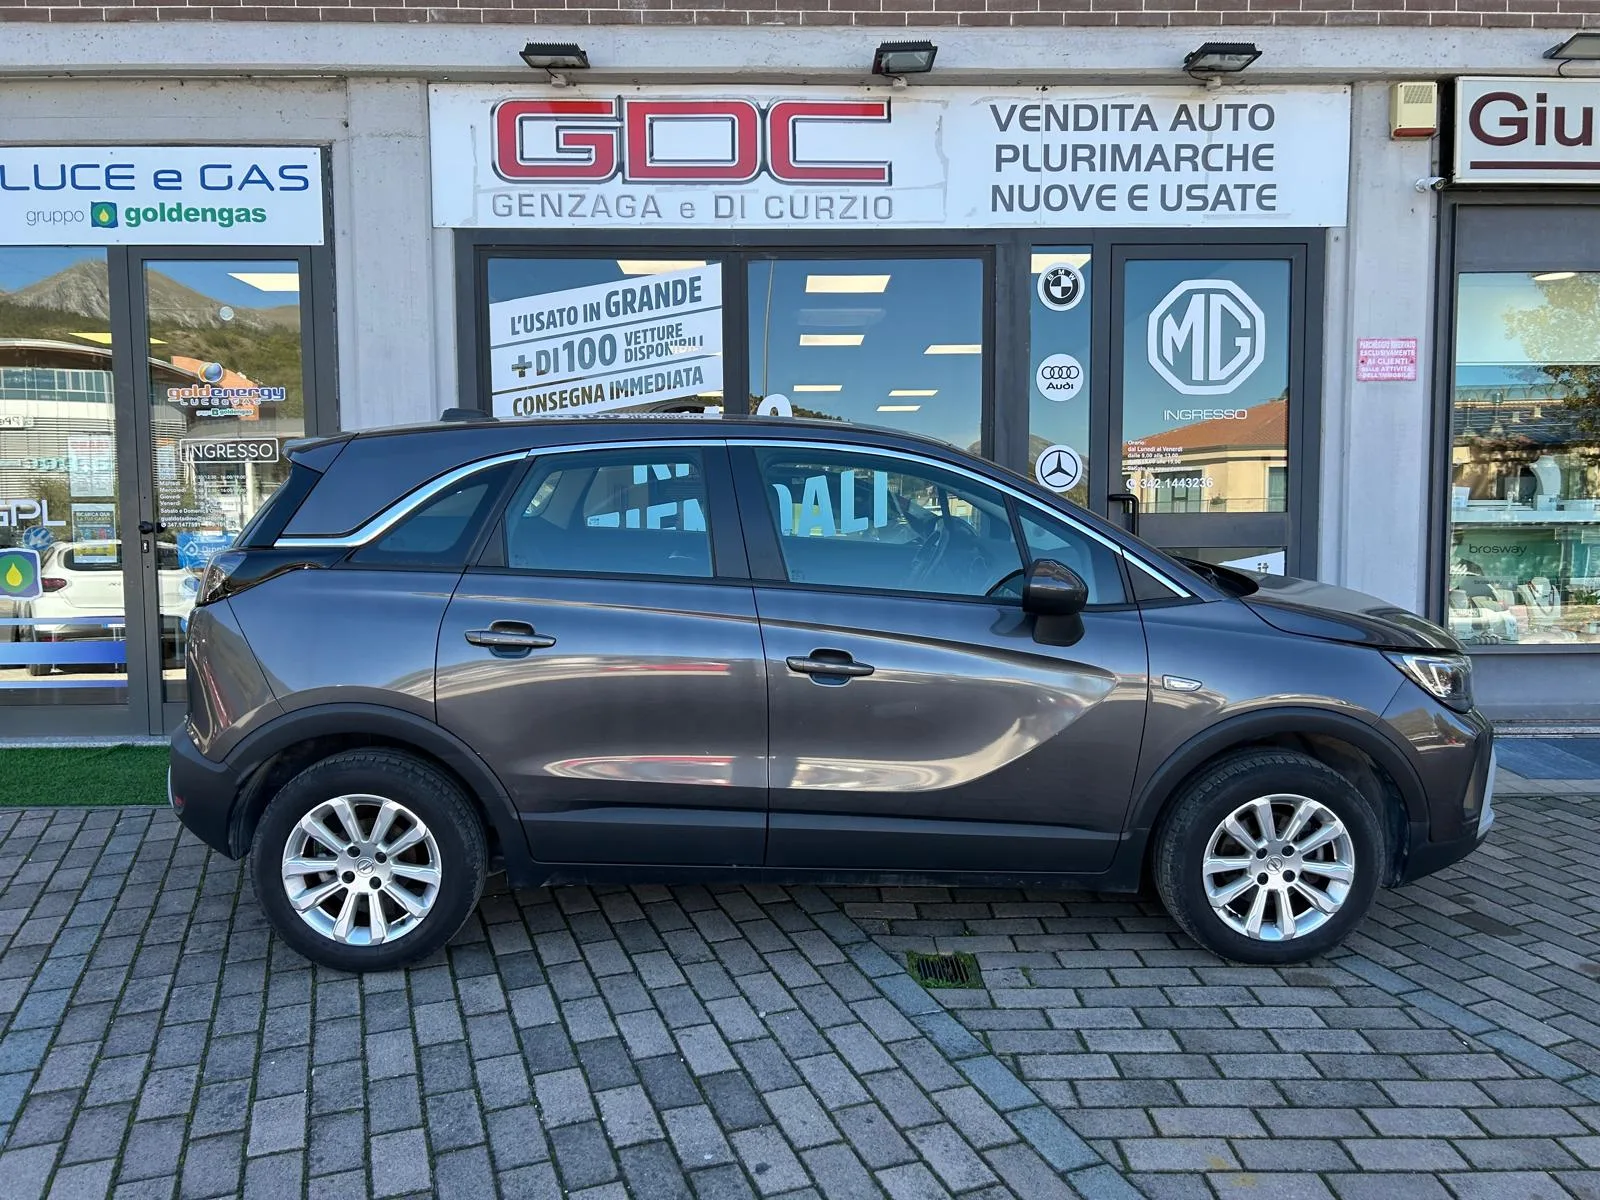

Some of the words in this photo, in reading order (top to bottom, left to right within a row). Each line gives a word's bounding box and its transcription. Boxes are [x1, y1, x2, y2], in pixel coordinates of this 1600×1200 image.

[989, 103, 1159, 132] VENDITA
[1168, 103, 1275, 132] AUTO
[1468, 91, 1594, 147] Giu
[490, 95, 893, 187] GDC
[994, 143, 1275, 173] PLURIMARCHE
[0, 164, 136, 192] LUCE
[152, 168, 183, 192] e
[199, 164, 310, 192] GAS
[491, 193, 662, 219] GENZAGA
[679, 199, 697, 219] e
[713, 194, 746, 220] DI
[764, 195, 894, 221] CURZIO
[990, 183, 1117, 213] NUOVE
[1127, 183, 1149, 212] E
[1159, 183, 1277, 212] USATE
[26, 208, 85, 227] gruppo
[124, 202, 268, 228] goldengas
[1047, 269, 1076, 281] BMW
[510, 305, 578, 336] L'USATO
[583, 301, 601, 323] IN
[604, 275, 702, 318] GRANDE
[536, 347, 560, 377] DI
[562, 332, 618, 373] 100
[624, 322, 683, 347] VETTURE
[1162, 293, 1252, 381] MG
[167, 384, 286, 402] goldenergy
[512, 383, 606, 418] CONSEGNA
[609, 365, 704, 400] IMMEDIATA
[1046, 381, 1074, 390] Audi
[1164, 409, 1248, 421] INGRESSO
[185, 443, 273, 458] INGRESSO
[1140, 478, 1214, 489] 342.1443236
[1469, 543, 1528, 557] brosway
